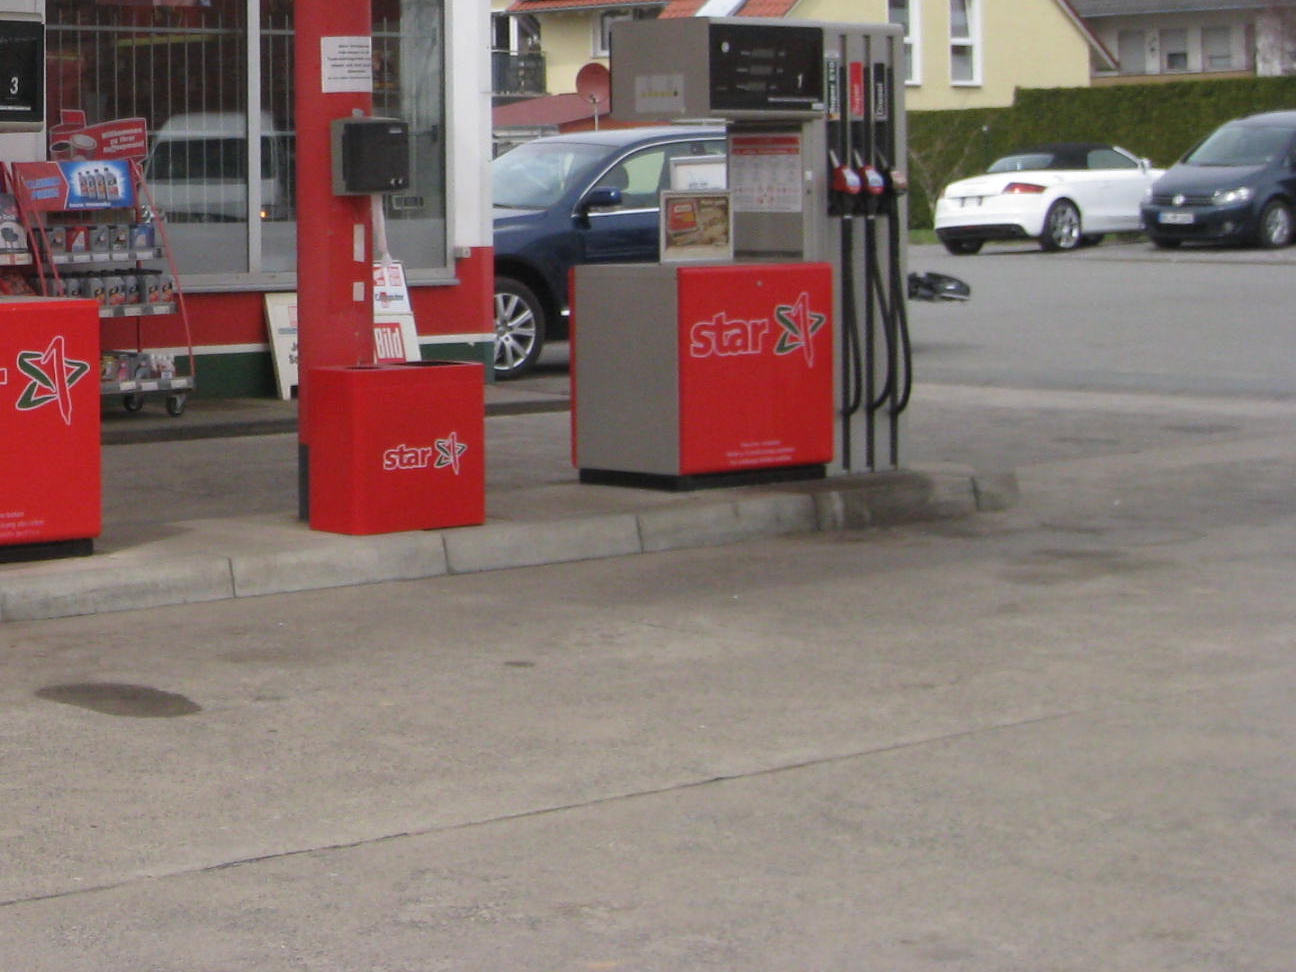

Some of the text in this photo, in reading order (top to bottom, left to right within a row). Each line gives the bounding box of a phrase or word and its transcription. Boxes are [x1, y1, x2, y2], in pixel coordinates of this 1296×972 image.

[10, 77, 19, 95] 3
[690, 311, 769, 358] star
[383, 444, 432, 470] star
